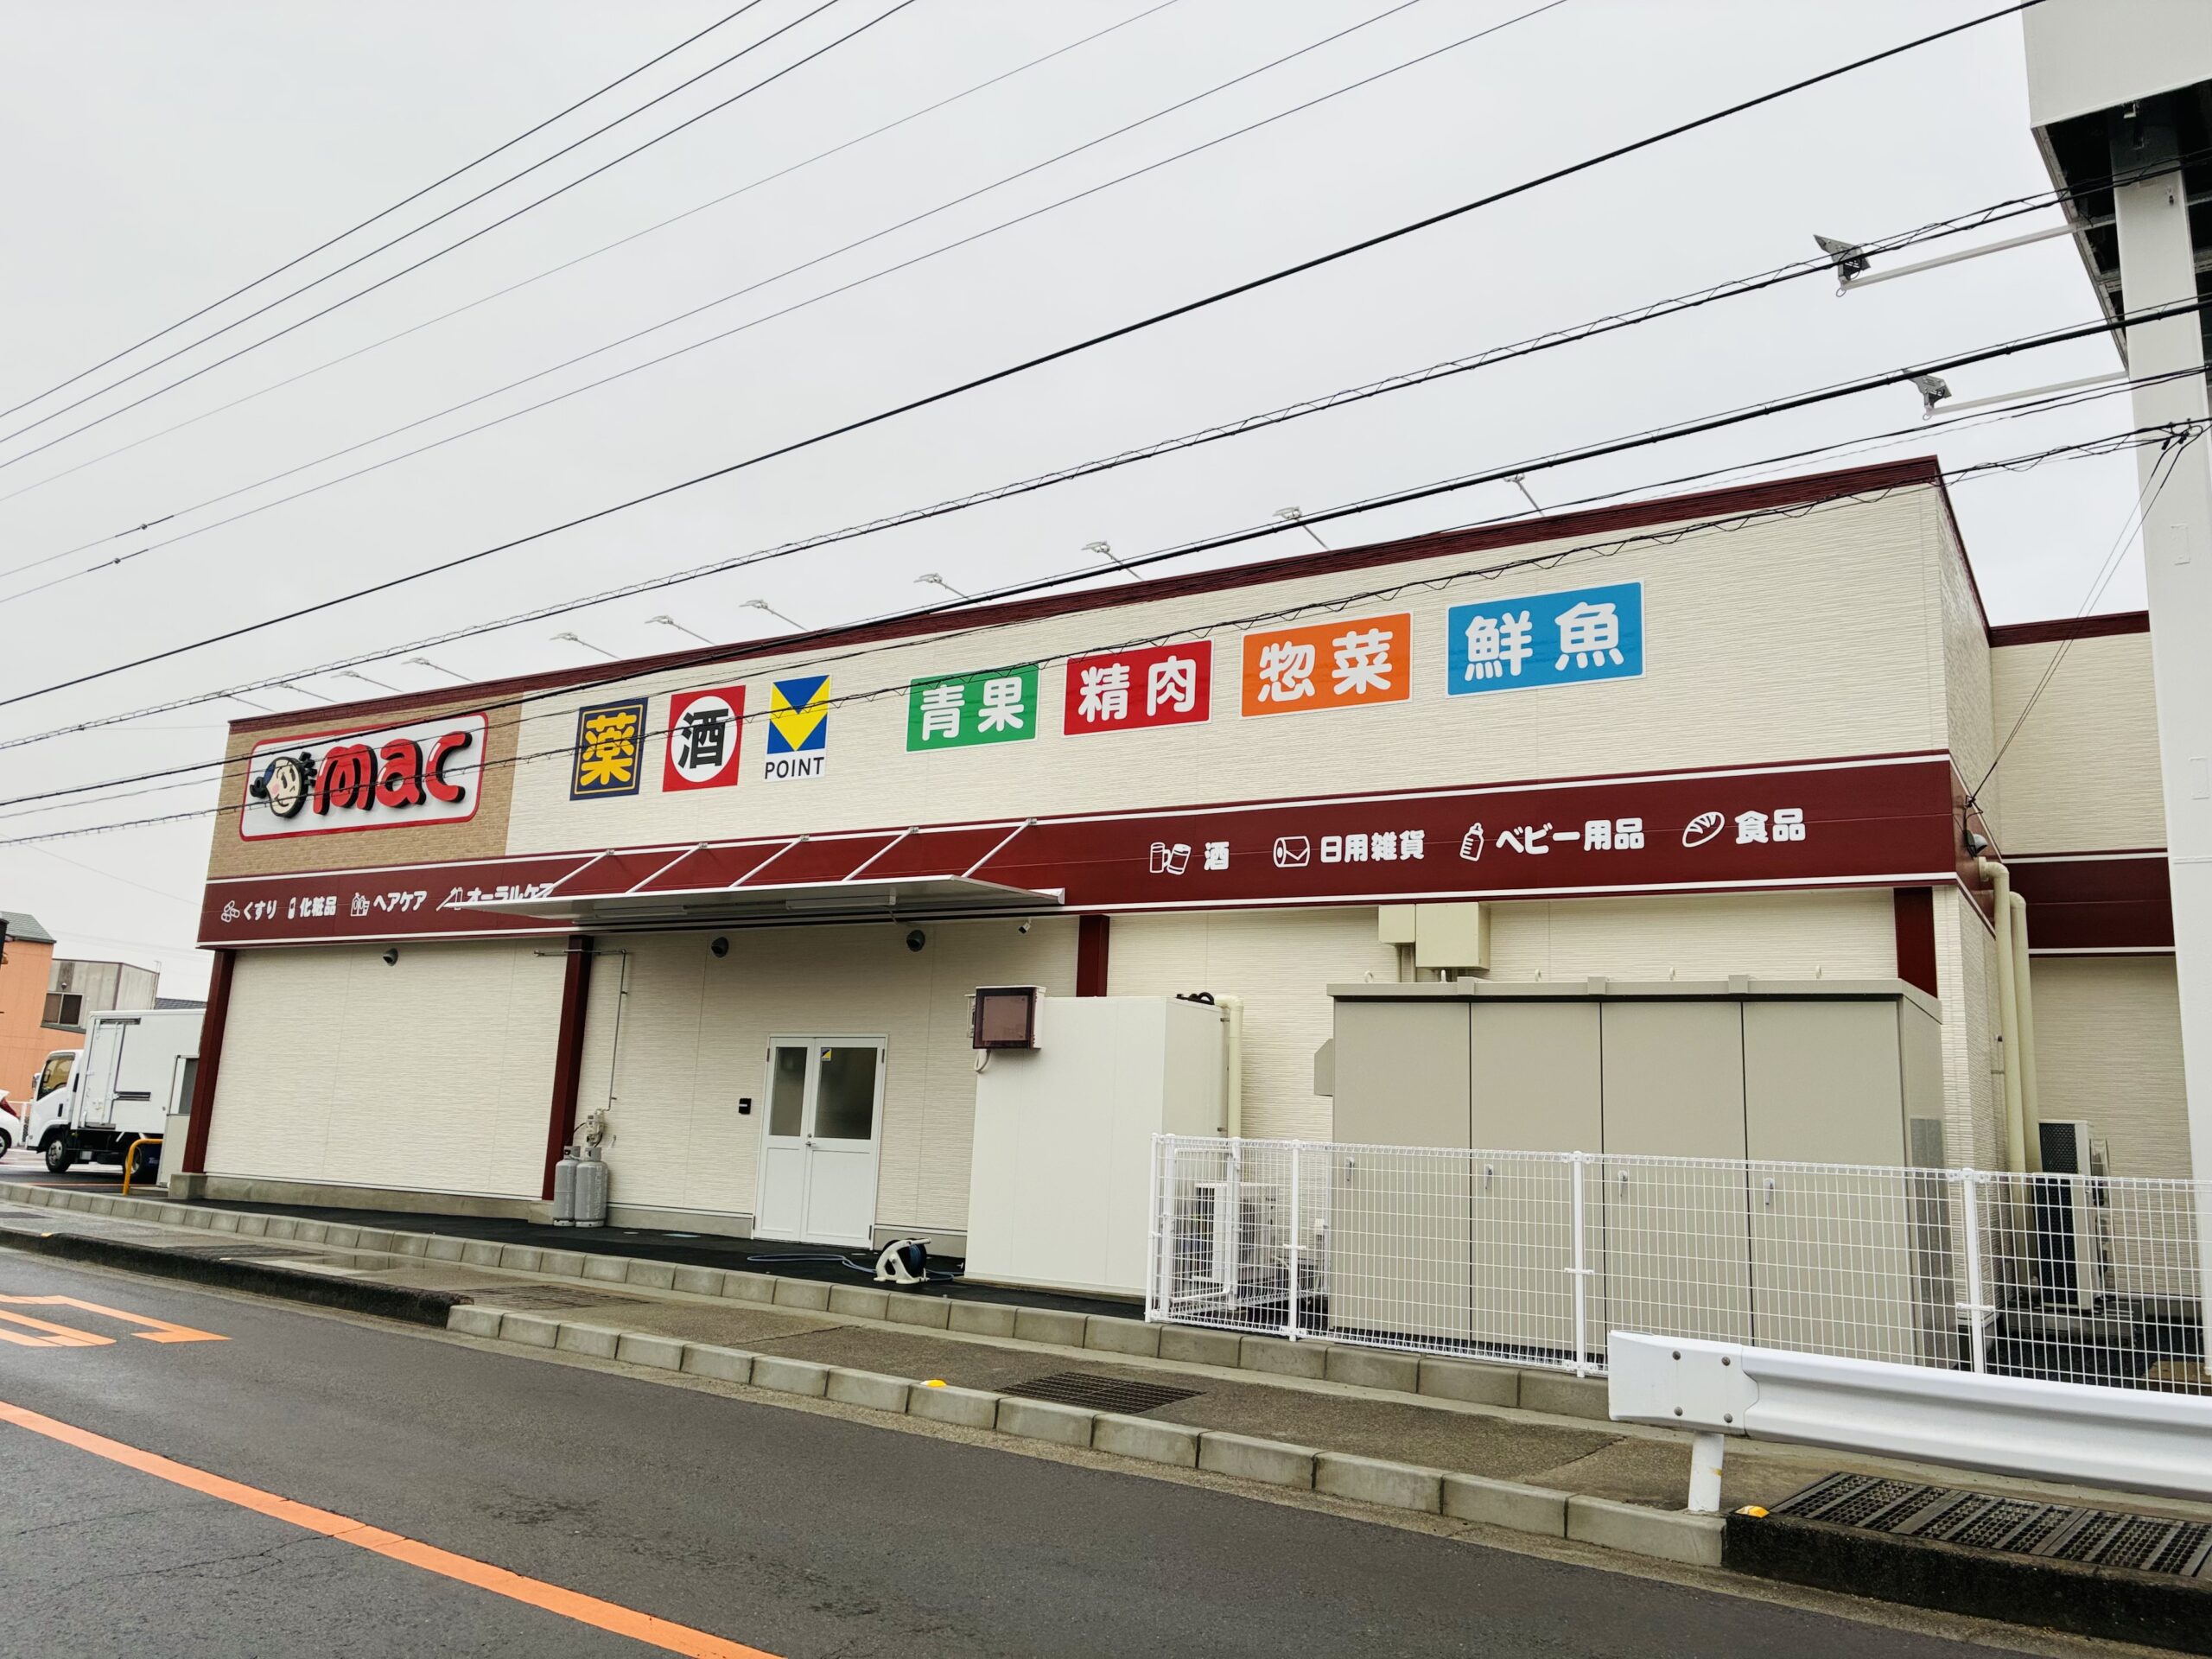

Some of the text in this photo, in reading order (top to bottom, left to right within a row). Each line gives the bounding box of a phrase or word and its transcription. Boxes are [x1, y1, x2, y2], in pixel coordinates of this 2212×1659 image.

[1464, 601, 1625, 681] 鮮魚
[1257, 627, 1393, 703] 惣菜
[1077, 654, 1197, 723] 精肉
[921, 676, 1025, 741] 青果
[580, 711, 638, 786] 薬
[677, 707, 732, 769] 酒
[313, 731, 473, 815] mac
[765, 756, 824, 779] POINT
[1496, 817, 1645, 855] ベビー用品
[1734, 808, 1806, 845] 食品
[1204, 842, 1230, 871] 酒
[1320, 830, 1426, 863] 日用雑貨
[243, 899, 277, 921] くすり
[299, 895, 338, 918] 化粧品
[372, 890, 428, 913] ヘアケア
